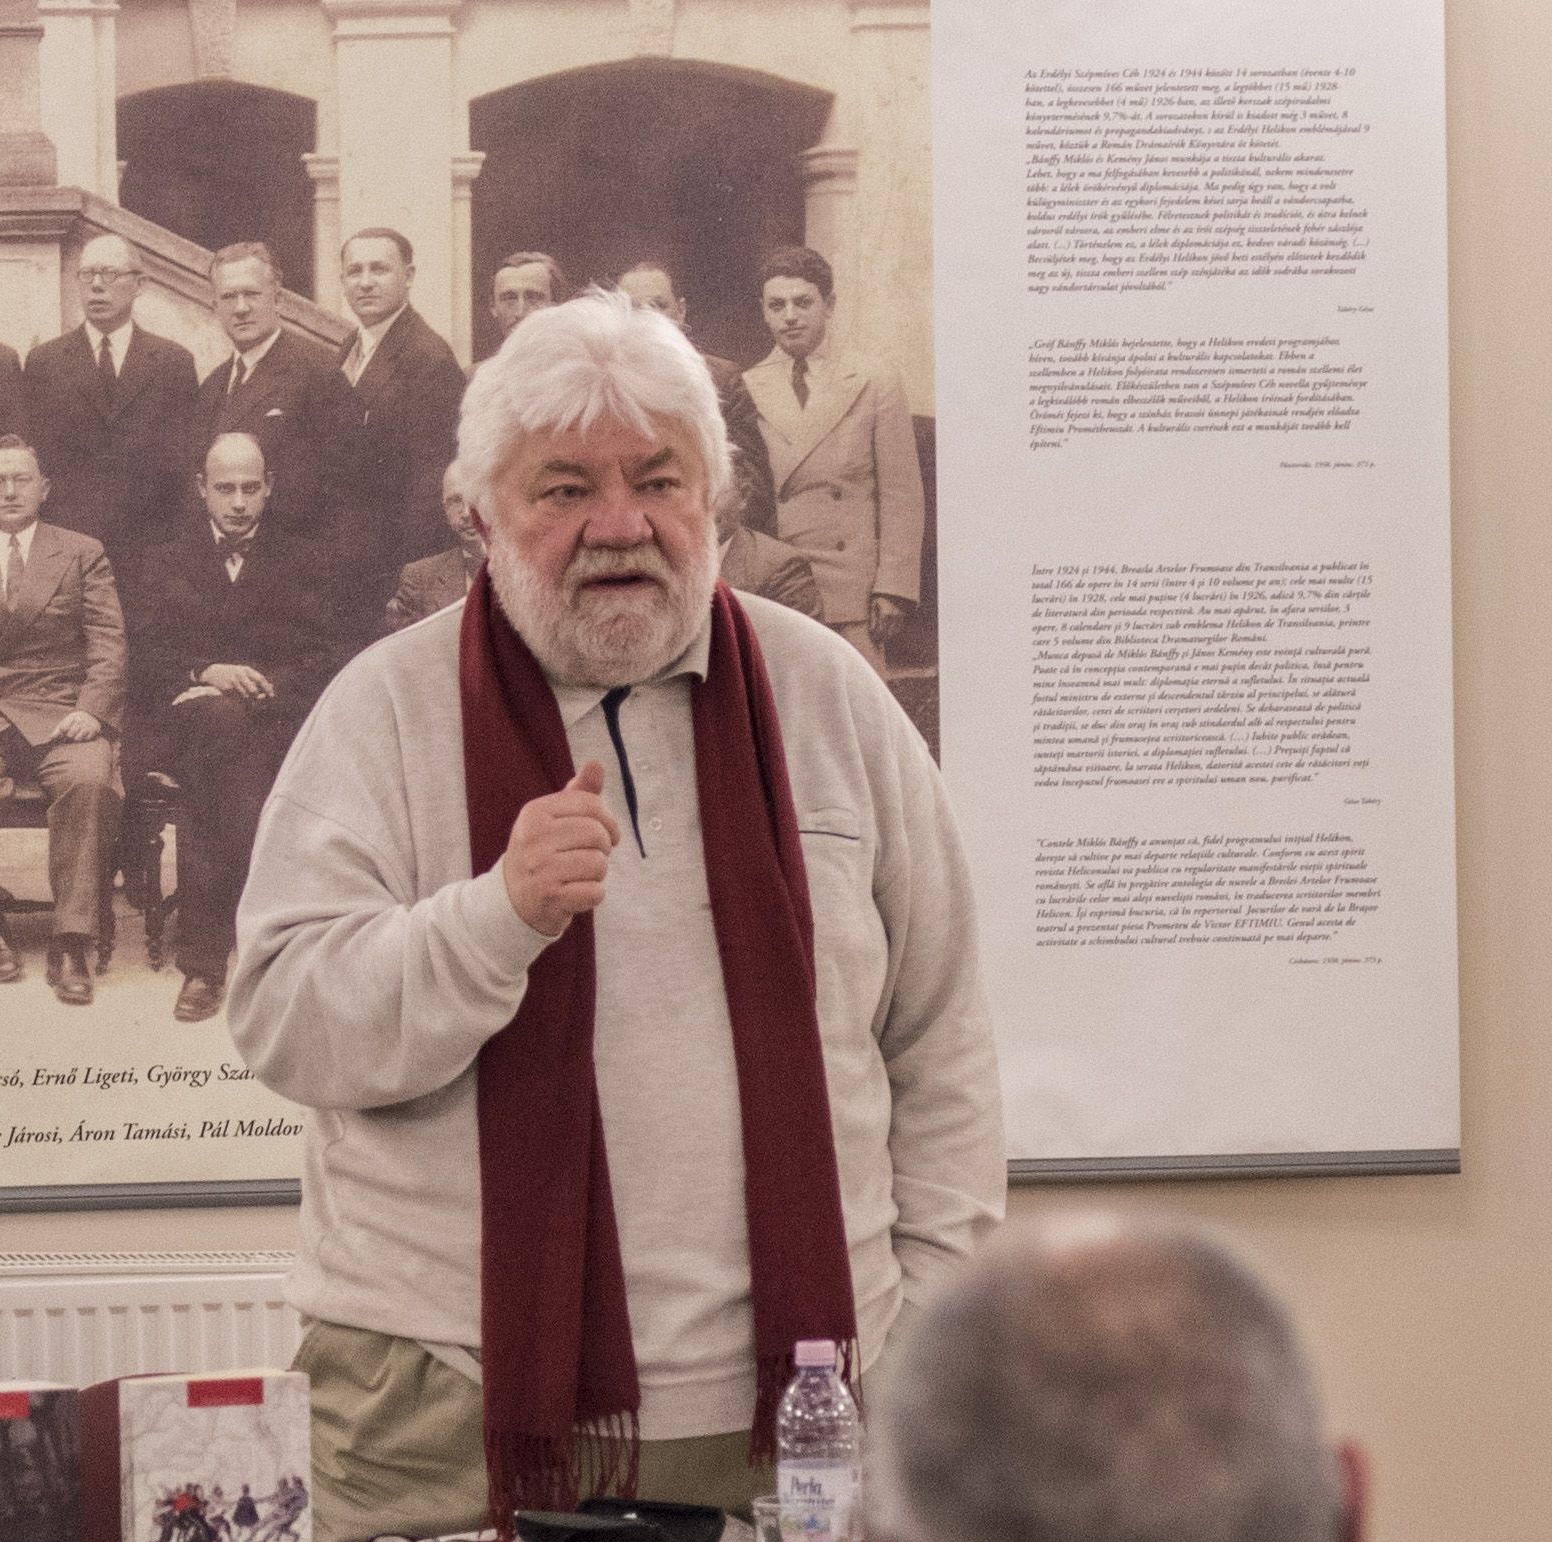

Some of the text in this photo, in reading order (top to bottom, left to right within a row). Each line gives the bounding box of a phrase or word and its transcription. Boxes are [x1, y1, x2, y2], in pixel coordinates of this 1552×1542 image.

[32, 1067, 78, 1086] Ernő
[83, 1067, 138, 1090] Ligeti,
[147, 1065, 212, 1088] György
[3, 1126, 63, 1148] Járosi,
[69, 1120, 115, 1142] Áron
[124, 1123, 191, 1140] Tamási,
[199, 1120, 230, 1138] Pál
[234, 1118, 303, 1137] Moldov
